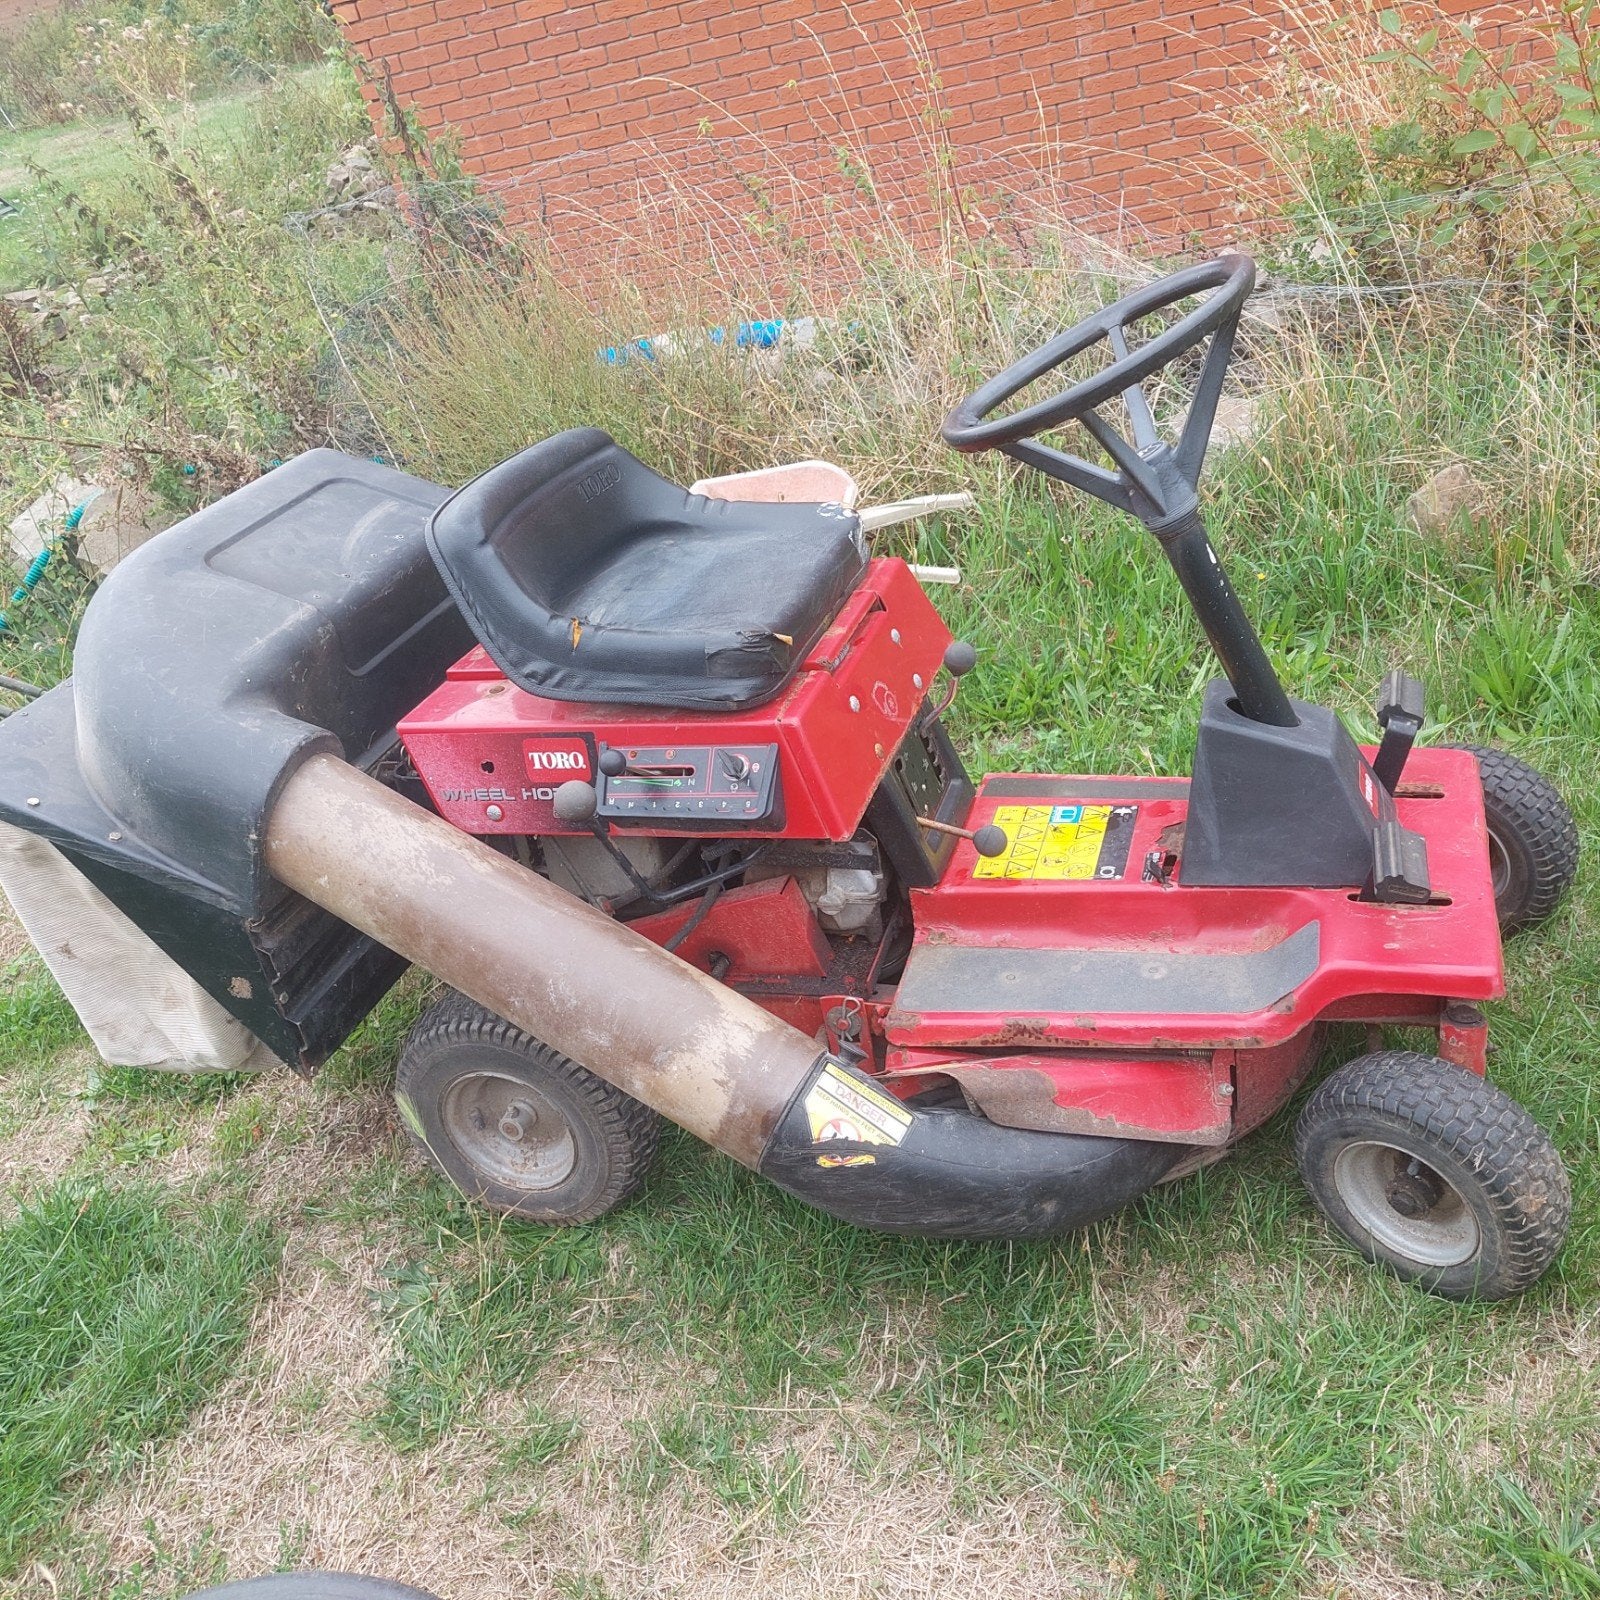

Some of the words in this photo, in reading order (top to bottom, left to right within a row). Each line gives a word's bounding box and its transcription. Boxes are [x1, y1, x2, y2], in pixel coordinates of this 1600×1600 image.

[576, 462, 621, 503] TORO
[442, 787, 516, 802] WHEEL
[816, 1089, 831, 1102] KEEP
[830, 1100, 850, 1117] HANDS
[861, 1121, 876, 1135] FEET
[834, 1082, 887, 1127] DANGER
